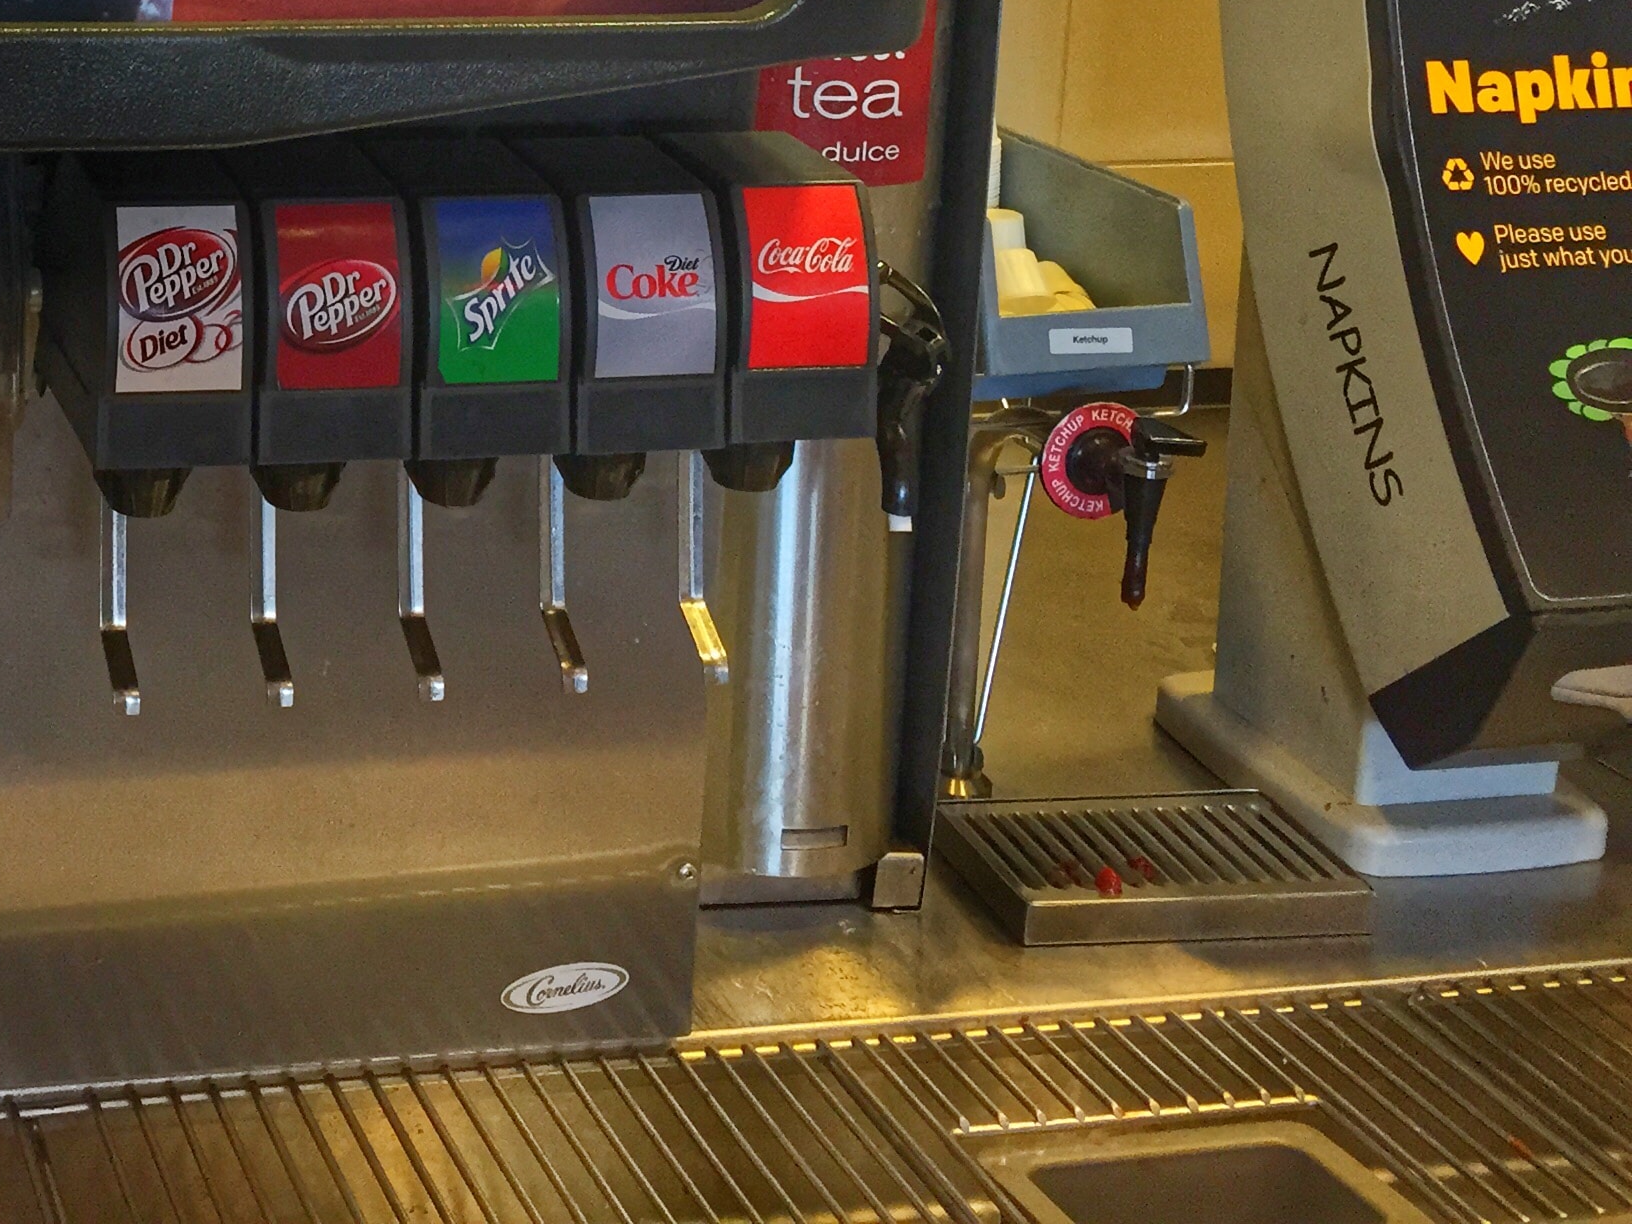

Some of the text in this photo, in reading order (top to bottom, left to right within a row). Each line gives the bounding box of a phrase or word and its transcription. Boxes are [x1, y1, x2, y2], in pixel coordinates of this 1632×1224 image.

[787, 66, 903, 120] tea
[821, 141, 901, 162] dulce
[1479, 150, 1556, 172] We use
[1483, 170, 1632, 196] 100% recycled
[1493, 223, 1607, 245] Please use
[156, 241, 196, 271] Dr
[664, 254, 700, 272] Diet
[757, 237, 857, 275] Coca-Cola
[1498, 246, 1632, 274] just what you
[131, 249, 225, 313] Pepper
[322, 268, 361, 303] Dr
[463, 250, 537, 344] Sprite
[606, 263, 700, 300] Coke
[298, 276, 387, 341] Pepper
[139, 325, 188, 363] Diet
[1072, 334, 1109, 345] Ketchup
[1308, 242, 1404, 507] NAPKINS
[1091, 408, 1134, 433] KETCH
[1048, 414, 1085, 473] KETCHUP
[1051, 478, 1104, 513] KETCHUP
